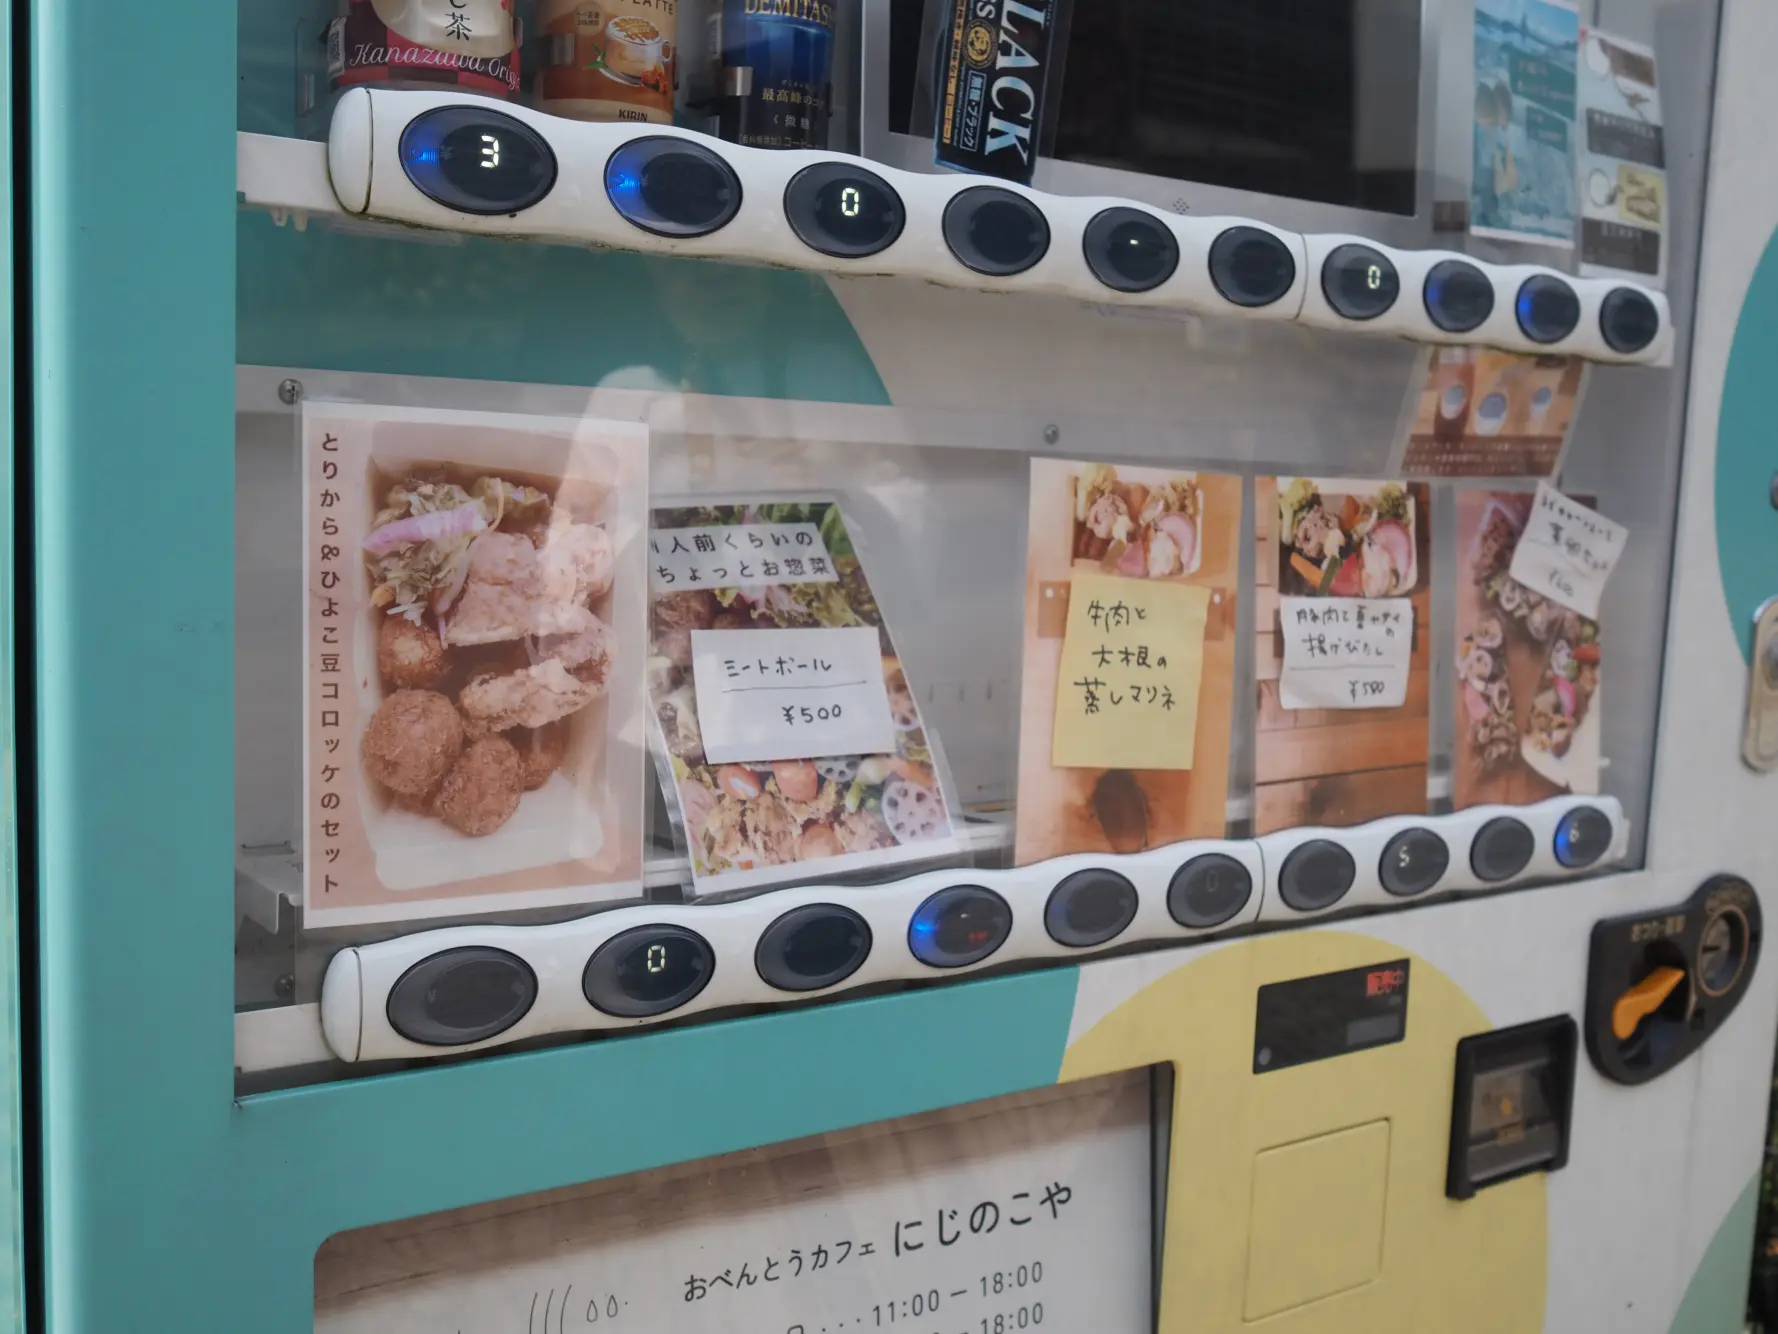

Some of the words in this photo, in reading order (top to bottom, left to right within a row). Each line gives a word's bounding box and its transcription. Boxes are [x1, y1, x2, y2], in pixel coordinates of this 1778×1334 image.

[350, 42, 484, 72] Kanazawa
[618, 109, 648, 121] KIRIN
[479, 134, 499, 169] 3
[841, 187, 860, 217] 0
[1367, 264, 1381, 290] 0
[656, 556, 831, 584] ちょっとお惣菜
[1087, 600, 1147, 634] 牛肉と
[320, 433, 341, 893] とりから&ひよこ豆コロッケのセット
[723, 656, 833, 678] ミートボール
[1091, 644, 1168, 670] 大根の
[1073, 676, 1176, 716] 蒸しマリネ
[782, 704, 842, 726] ¥500
[646, 943, 666, 973] 0
[684, 1240, 877, 1302] おべんとうカフェ
[894, 1180, 1074, 1258] にじのこや
[980, 1261, 1044, 1298] 18:00
